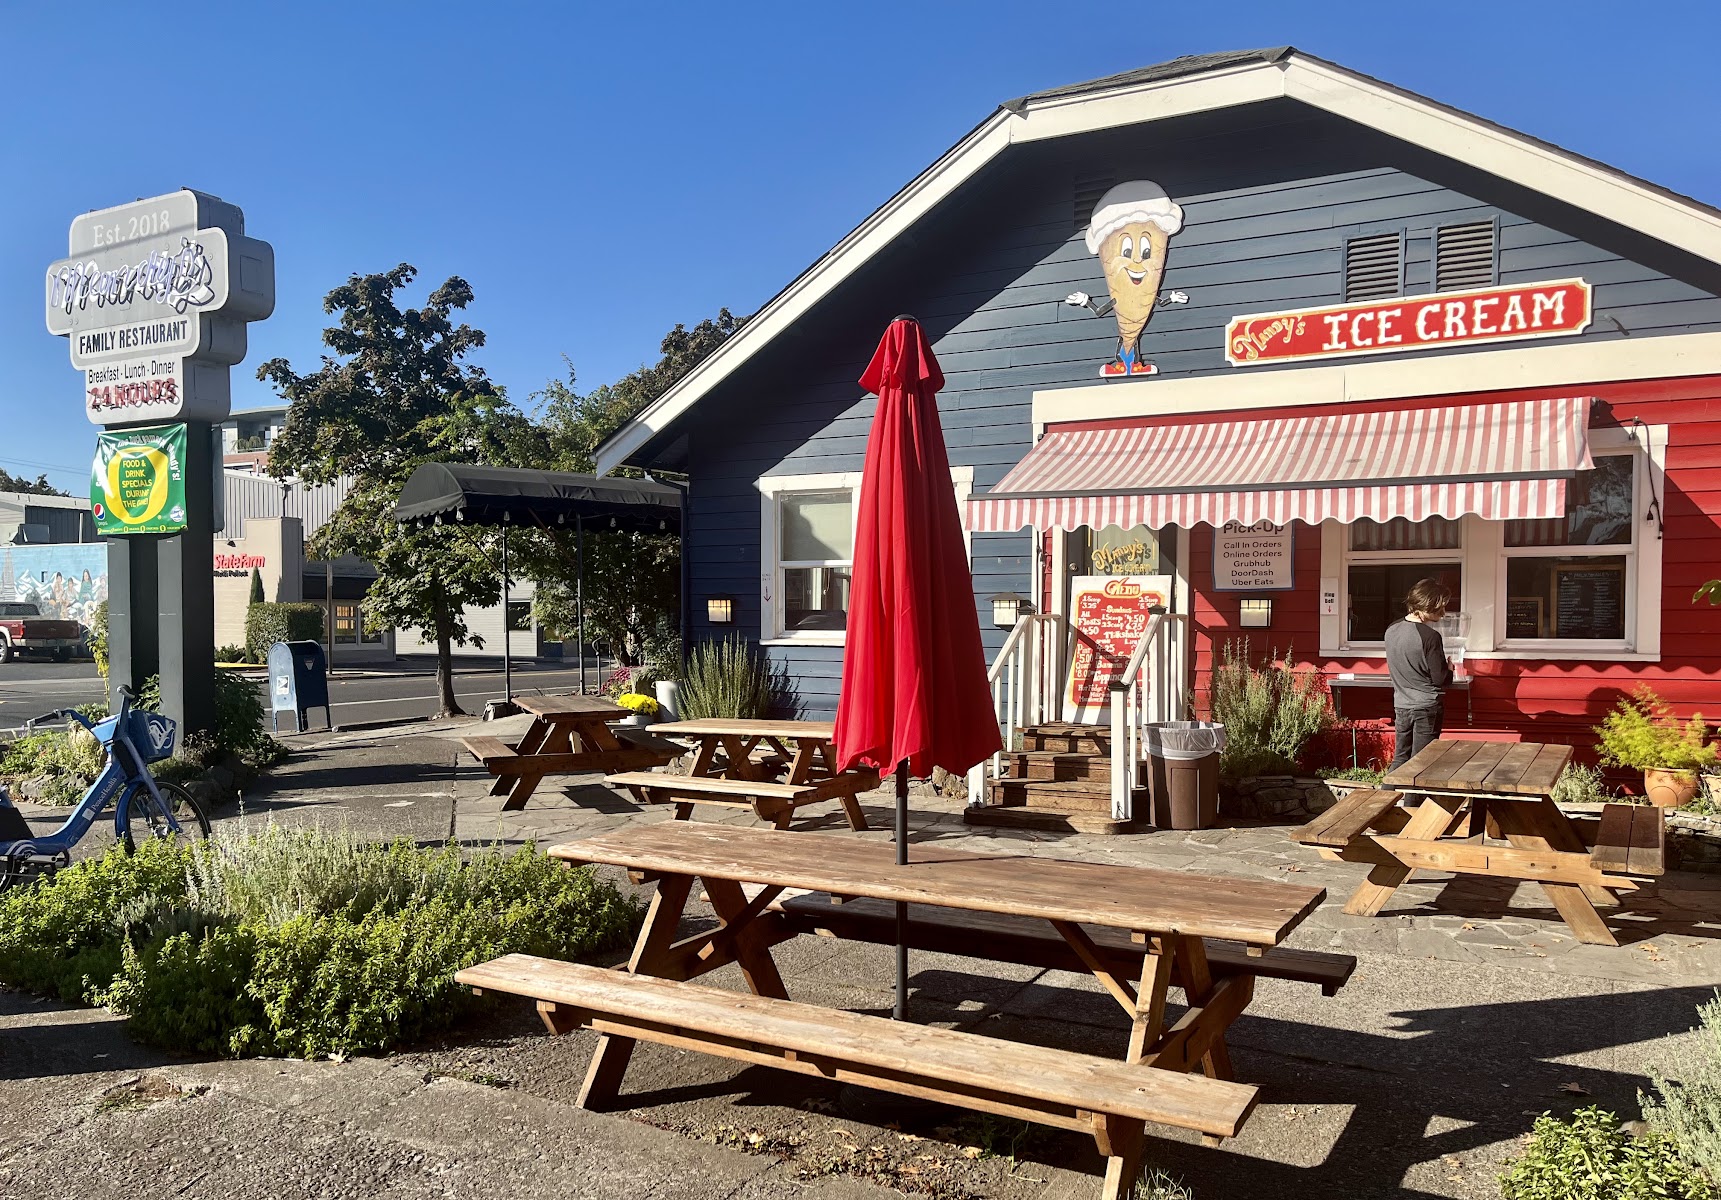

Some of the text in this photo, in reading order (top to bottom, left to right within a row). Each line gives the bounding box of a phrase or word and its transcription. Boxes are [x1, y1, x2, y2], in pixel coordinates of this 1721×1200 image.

[93, 210, 170, 248] Est. 2018
[1232, 289, 1567, 361] Mandy's ICE CREAM
[79, 320, 188, 355] FAMILY RESTAURANT
[88, 366, 120, 384] Breakfast
[124, 363, 146, 379] Lunch
[151, 360, 176, 375] Dinner
[122, 459, 147, 468] FOOD &
[125, 469, 146, 478] DRINK
[121, 478, 153, 489] SPECIALS
[122, 500, 137, 508] THE
[1223, 521, 1285, 535] Pick-Up
[1242, 541, 1250, 549] In
[1252, 550, 1283, 558] Orders
[1233, 559, 1271, 567] Grubhub
[1111, 563, 1123, 573] ICE
[1231, 569, 1274, 577] DoorDash
